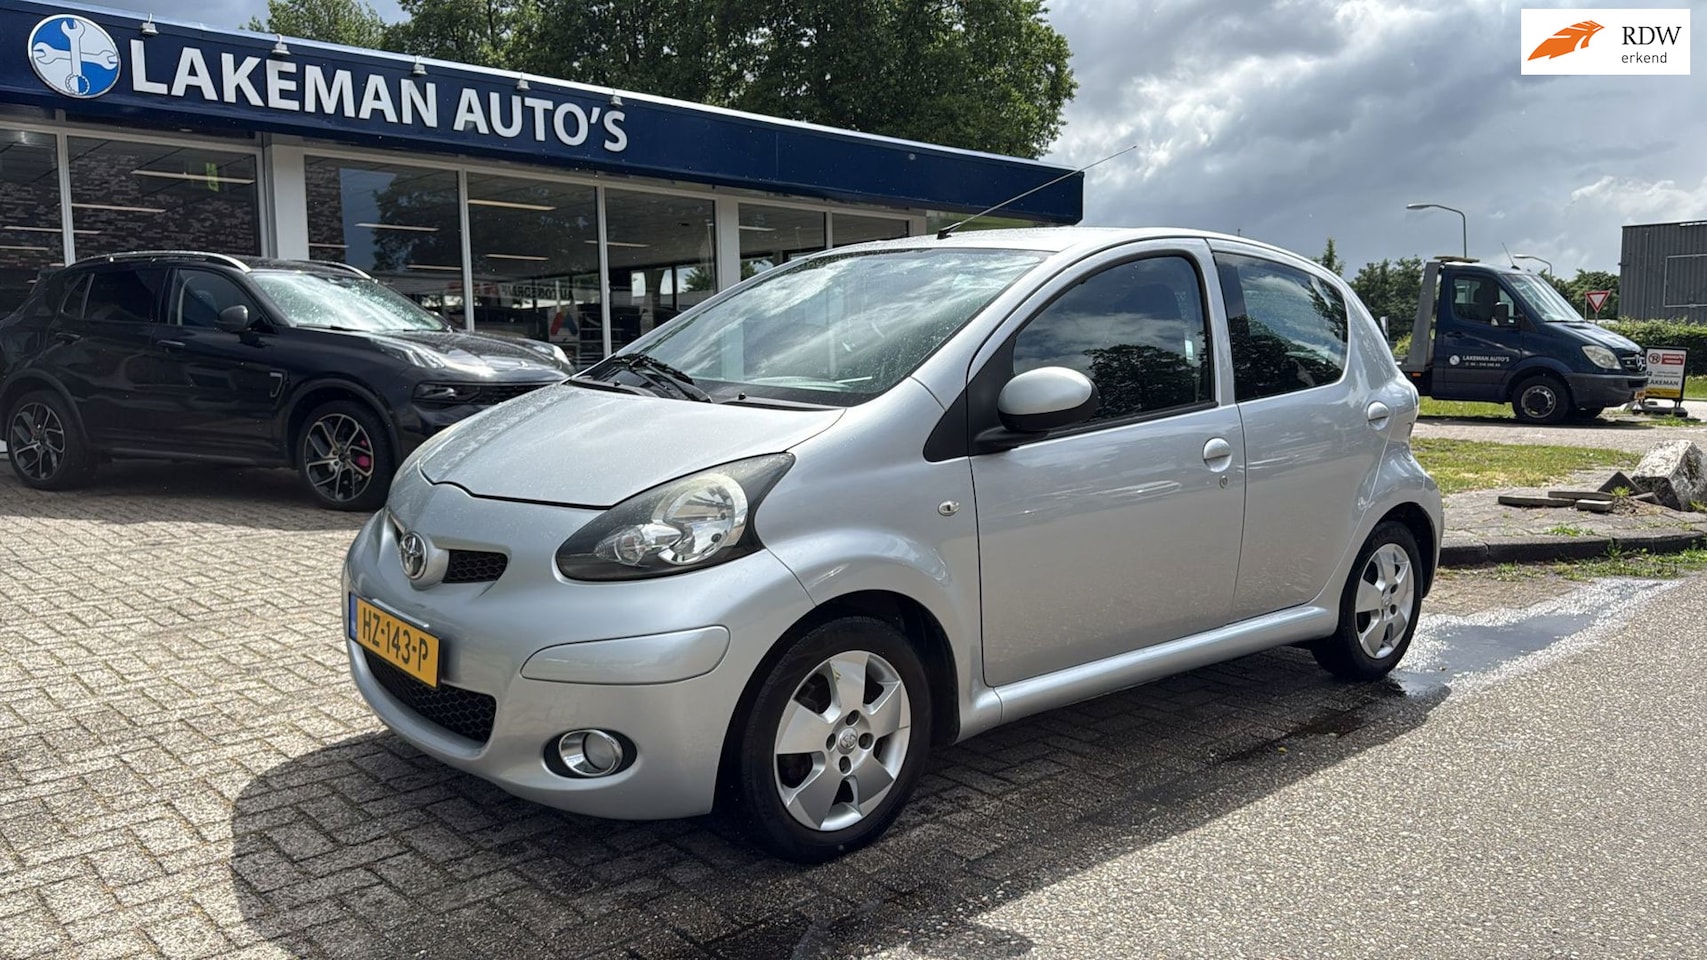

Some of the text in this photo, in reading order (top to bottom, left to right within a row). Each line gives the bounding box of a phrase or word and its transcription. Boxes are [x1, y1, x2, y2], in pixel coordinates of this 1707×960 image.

[130, 38, 629, 152] LAKEMAN AUTO'S
[362, 606, 429, 673] HZ-143-P
